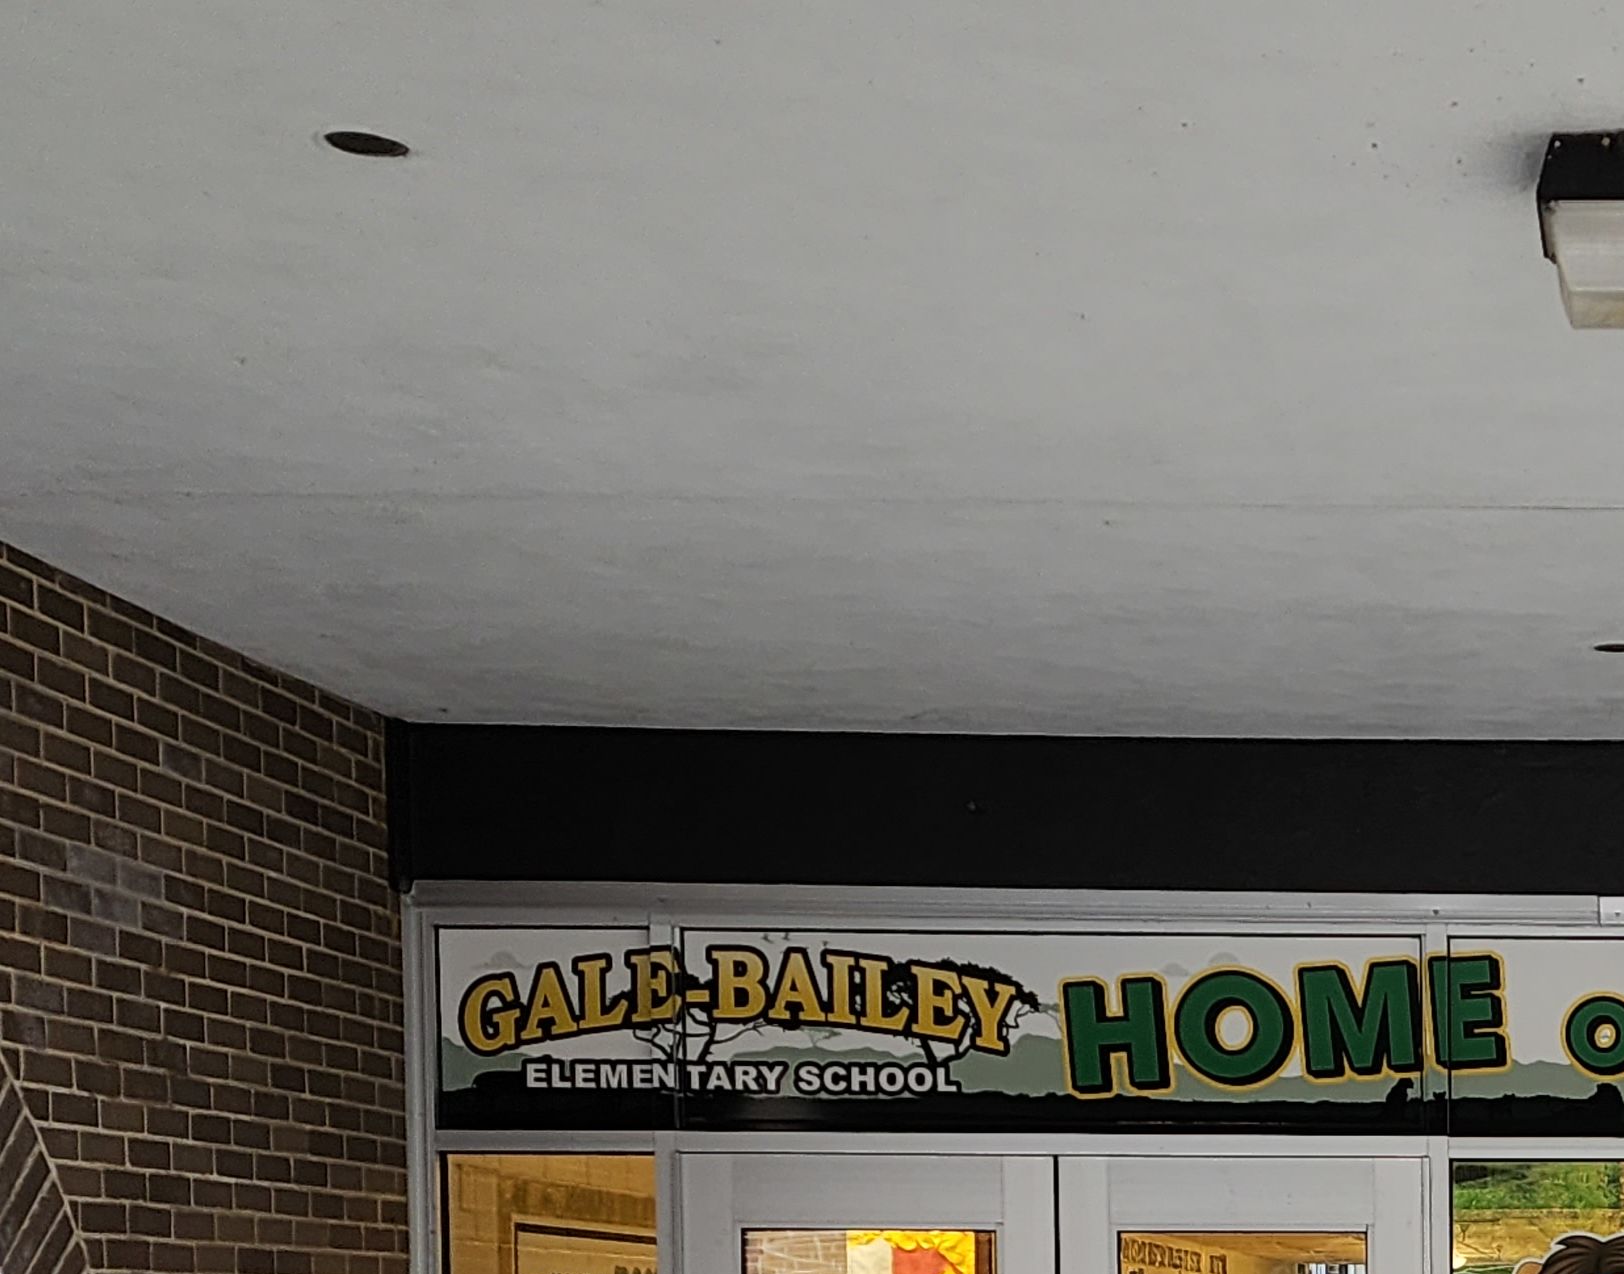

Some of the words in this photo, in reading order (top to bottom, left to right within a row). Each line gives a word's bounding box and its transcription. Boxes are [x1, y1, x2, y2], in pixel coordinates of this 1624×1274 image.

[460, 945, 1017, 1054] GALE-BAILEY
[1060, 951, 1511, 1099] HOME
[525, 1063, 783, 1092] ELEMENTARY
[794, 1065, 958, 1094] SCHOOL
